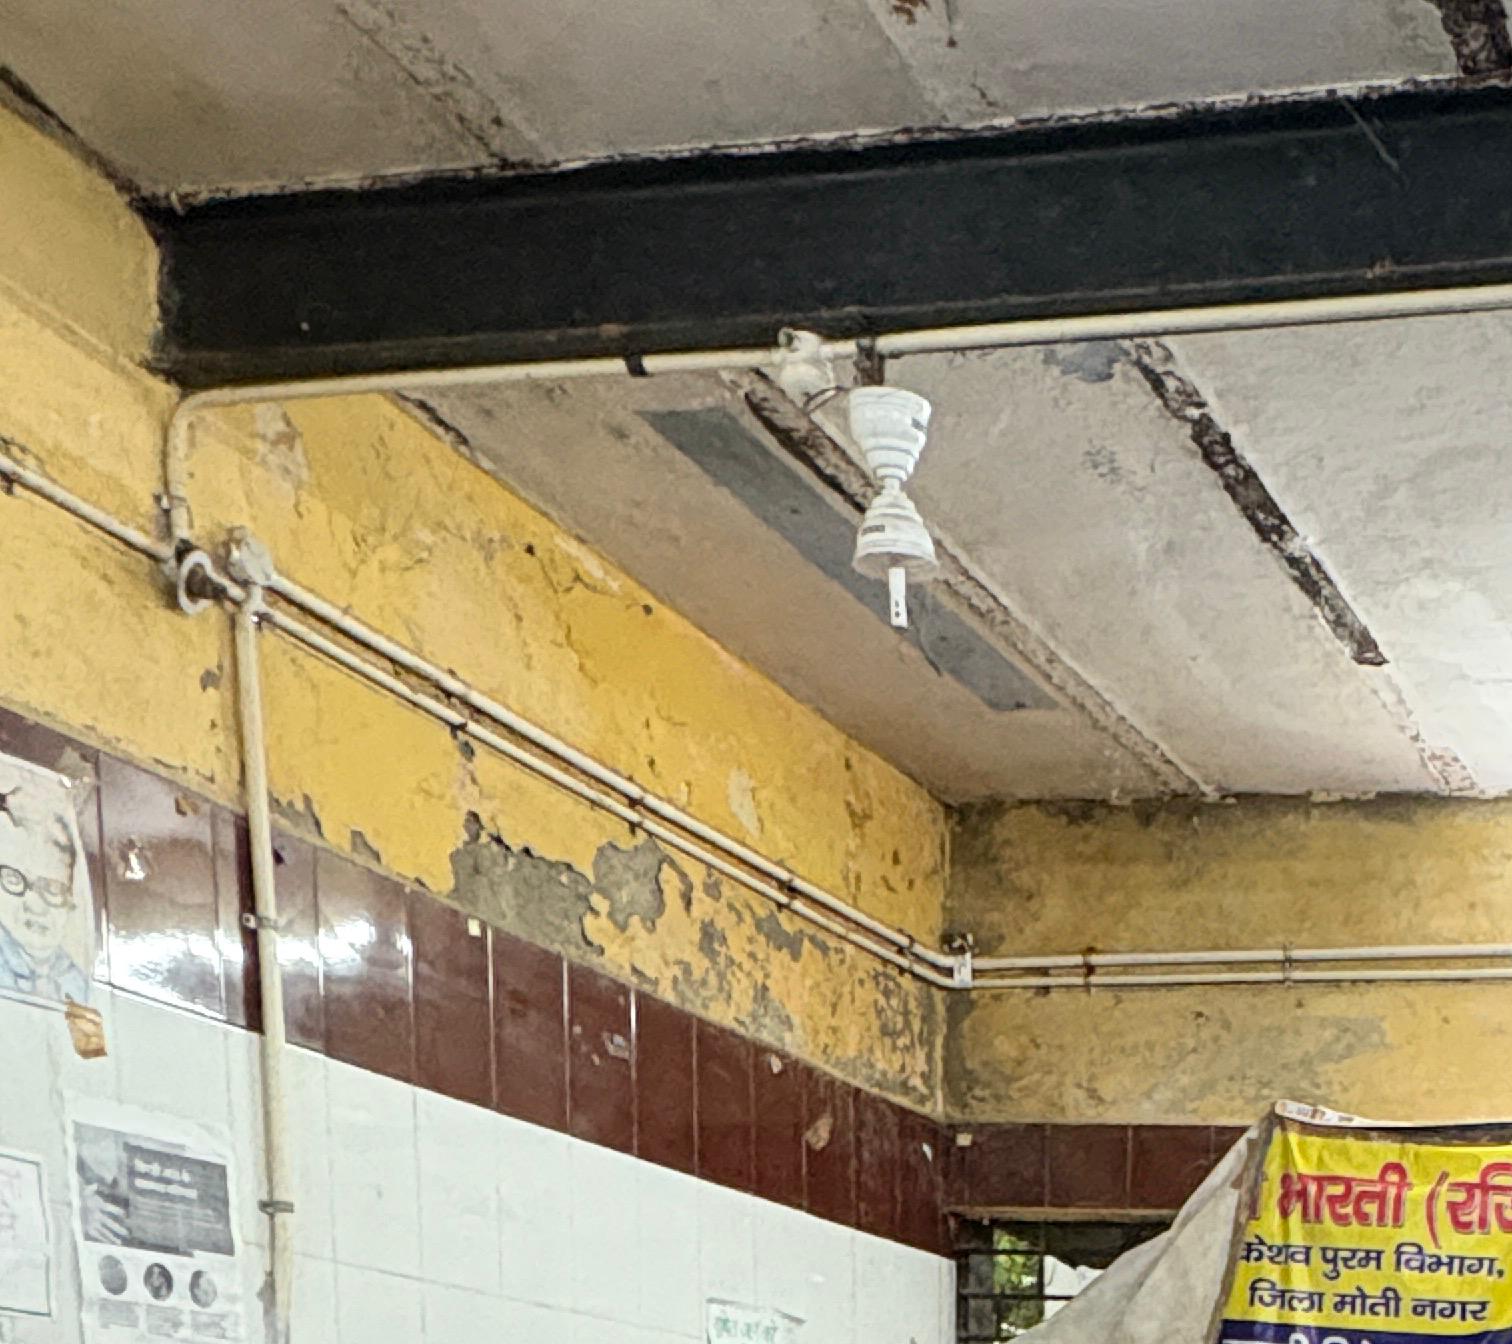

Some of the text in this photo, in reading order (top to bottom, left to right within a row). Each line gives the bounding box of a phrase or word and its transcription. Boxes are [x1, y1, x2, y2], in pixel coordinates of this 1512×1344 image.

[1278, 1162, 1412, 1228] भारती
[1240, 1234, 1504, 1280] केशव पुरम विभाग,
[1249, 1277, 1490, 1321] जिला मोती नगर
